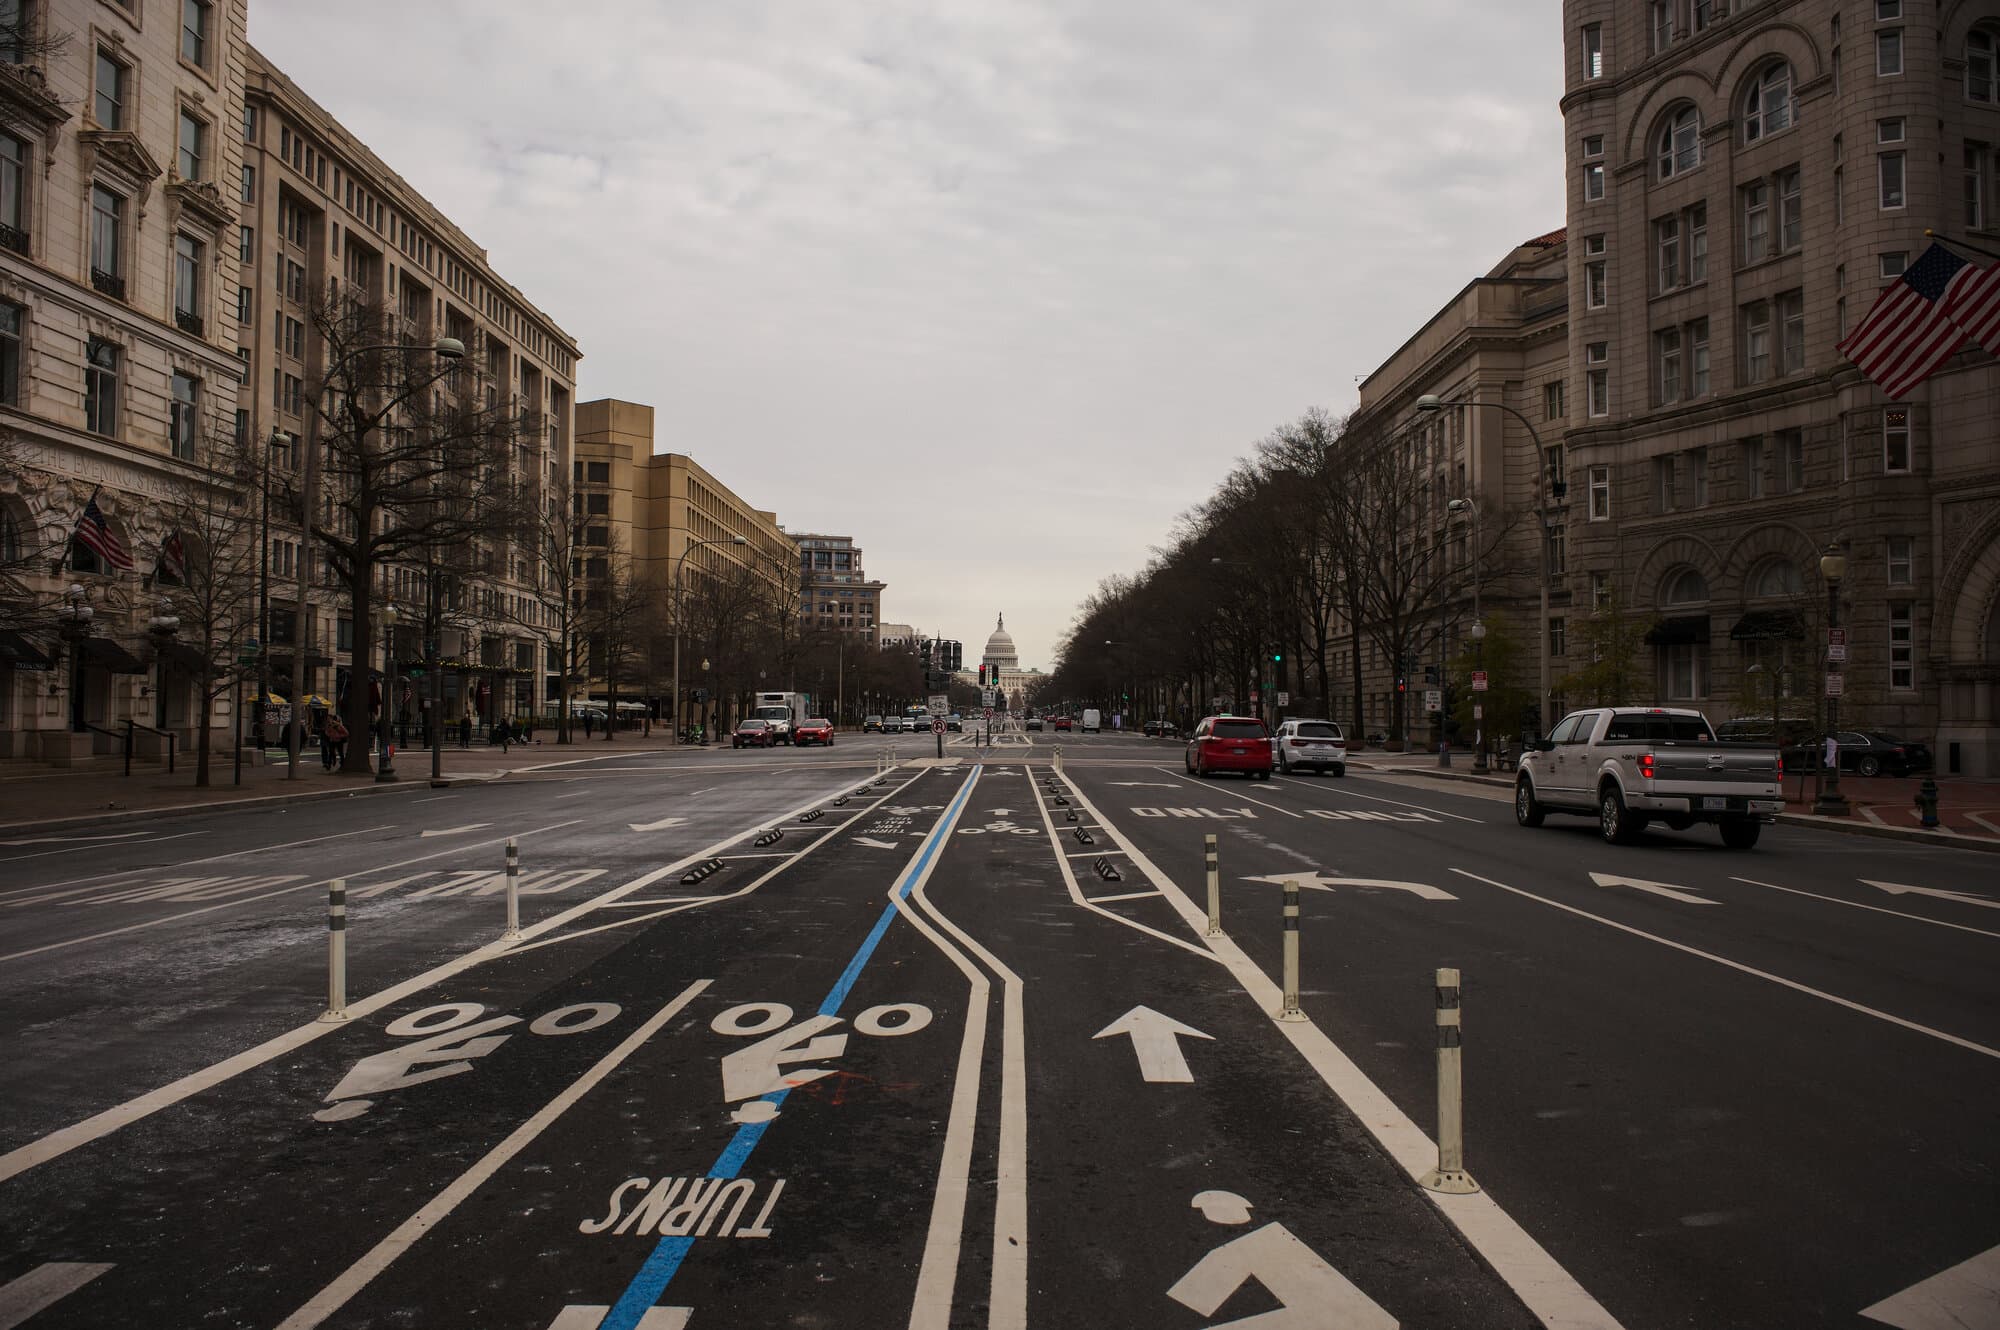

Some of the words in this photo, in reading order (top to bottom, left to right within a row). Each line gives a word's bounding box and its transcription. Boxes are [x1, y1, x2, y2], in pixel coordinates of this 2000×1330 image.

[38, 446, 65, 470] THE
[74, 455, 131, 486] EVENING
[1128, 806, 1260, 819] ONLY
[1303, 809, 1444, 822] ONLY
[318, 868, 610, 898] ONLY
[578, 1176, 786, 1239] TURNS
